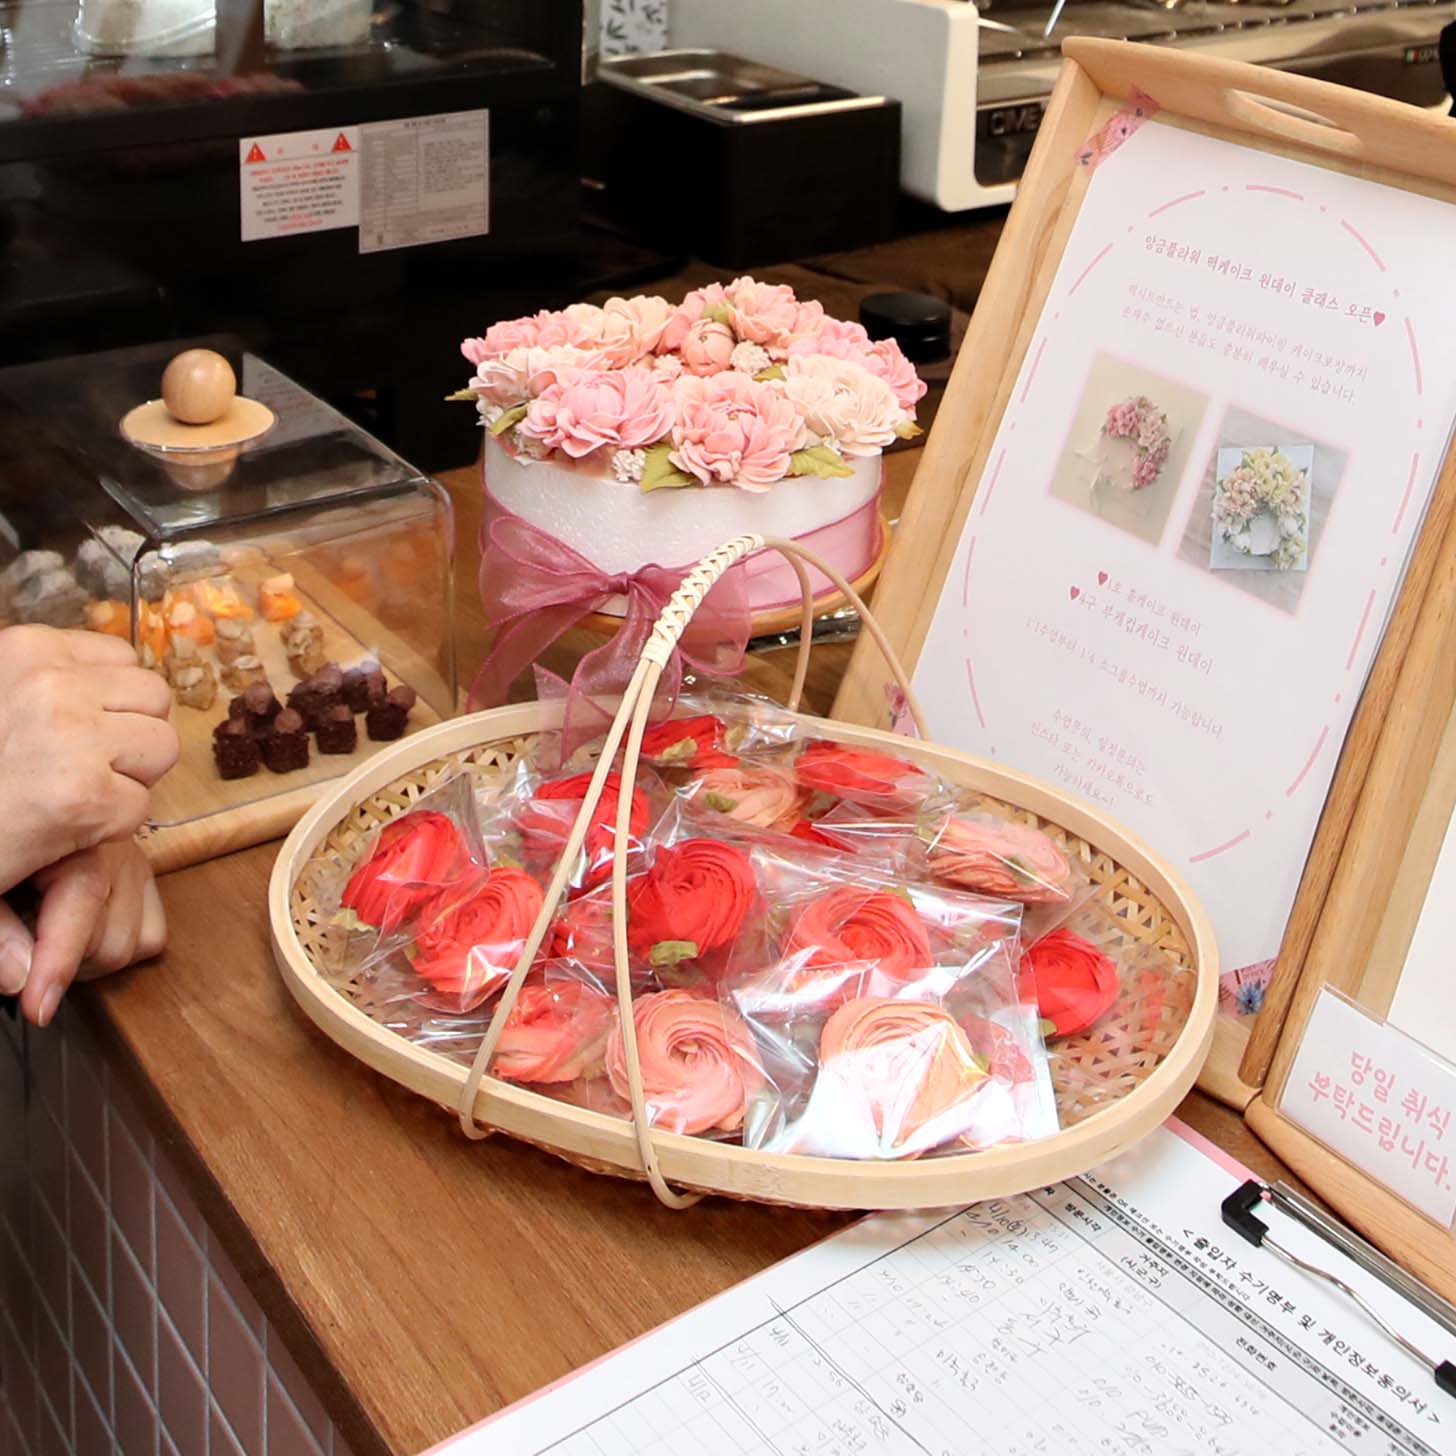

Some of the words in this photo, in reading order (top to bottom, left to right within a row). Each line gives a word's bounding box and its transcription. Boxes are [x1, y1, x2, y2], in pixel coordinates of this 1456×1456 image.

[1145, 235, 1201, 265] 앙금플라워
[1258, 271, 1296, 297] 원데이
[1301, 287, 1339, 311] 클래스
[1294, 370, 1305, 385] 수
[1308, 1071, 1453, 1191] 부탁드립니다.
[1350, 1051, 1396, 1103] 당일
[1401, 1089, 1452, 1141] 취식
[1194, 1237, 1237, 1271] 출입자
[1239, 1269, 1298, 1316] 수기명부
[1298, 1313, 1318, 1332] 및
[1318, 1328, 1429, 1415] 개인정보동의서
[1235, 1336, 1279, 1373] 전화번호
